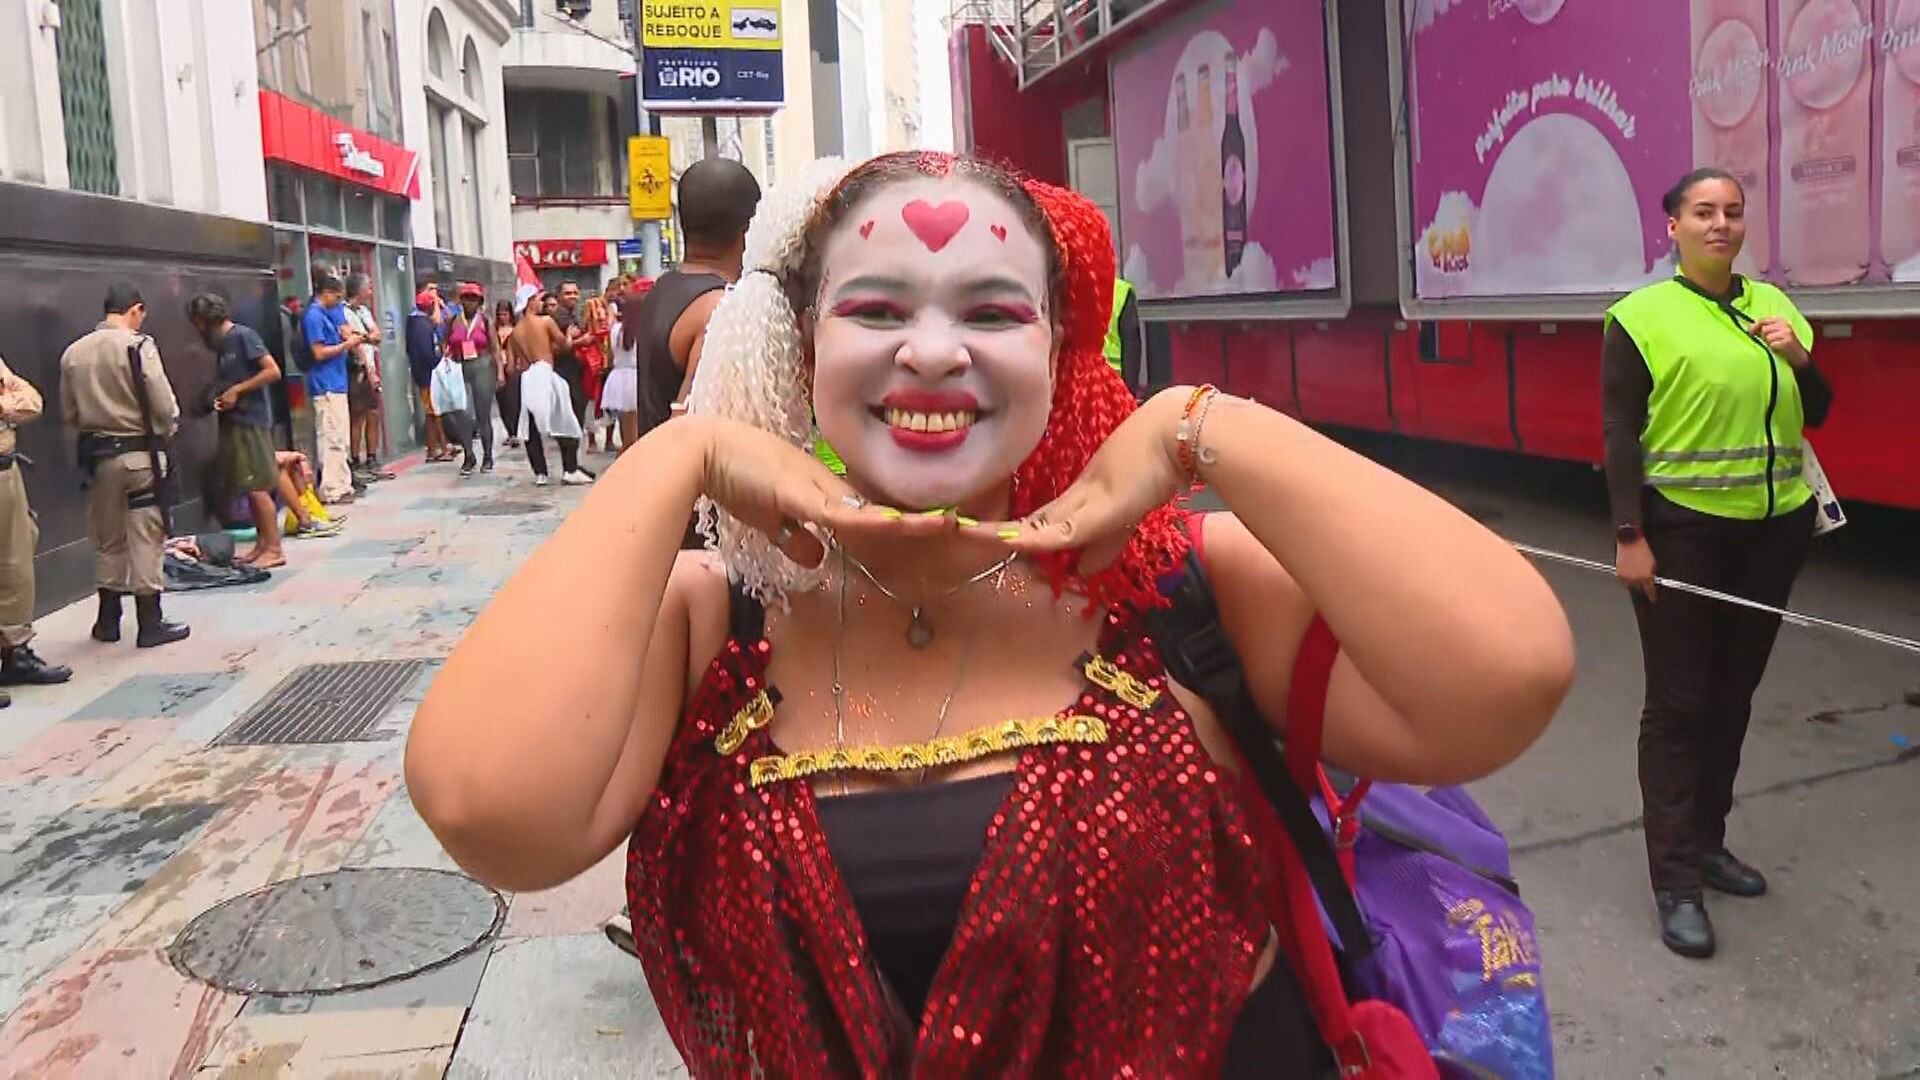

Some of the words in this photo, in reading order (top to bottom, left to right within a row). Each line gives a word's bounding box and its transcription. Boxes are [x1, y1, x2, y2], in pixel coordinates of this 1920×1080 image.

[645, 5, 706, 19] SUJEITO
[710, 7, 720, 18] A
[646, 23, 722, 38] REBOQUE
[679, 67, 720, 88] RIO
